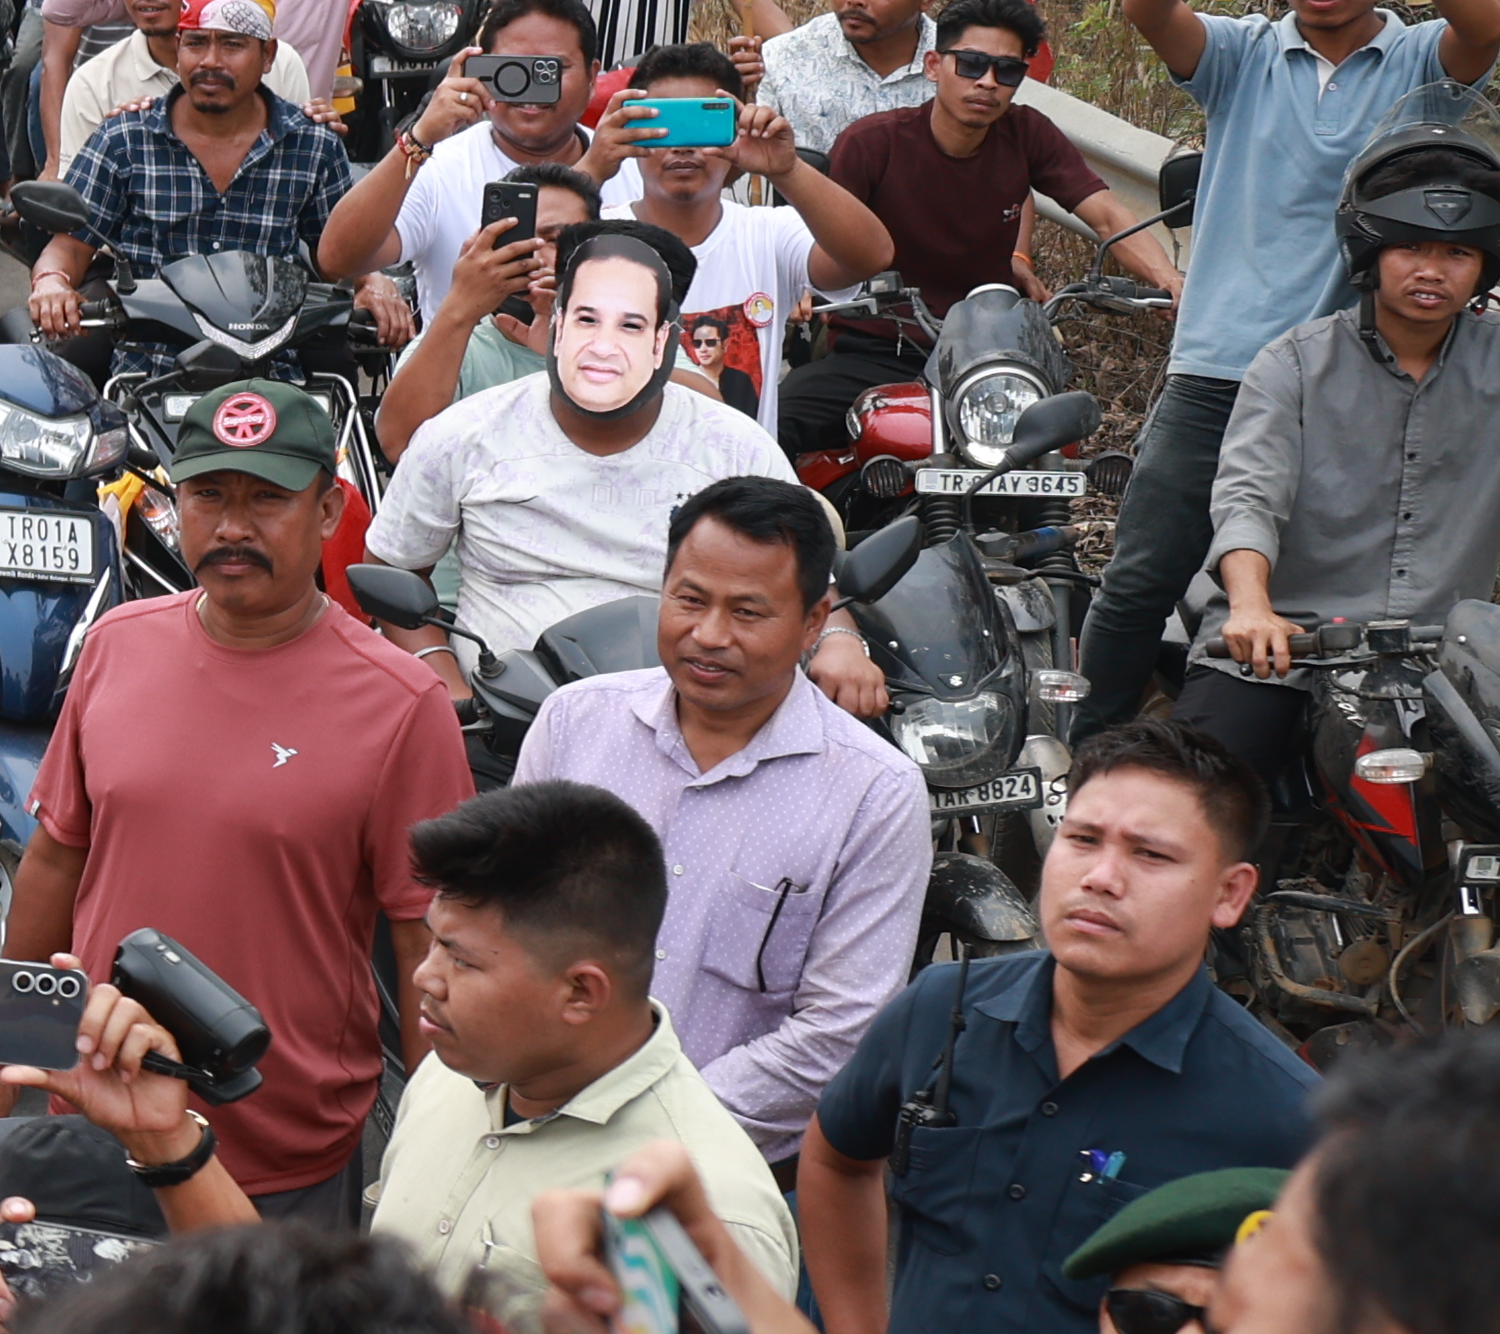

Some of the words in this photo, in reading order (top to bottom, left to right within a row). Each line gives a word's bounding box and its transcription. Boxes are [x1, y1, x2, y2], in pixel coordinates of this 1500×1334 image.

[228, 322, 270, 331] HONDA
[223, 413, 265, 427] Superboy
[7, 515, 79, 544] TR01A
[7, 543, 80, 571] X8159
[978, 775, 1032, 803] 8824
